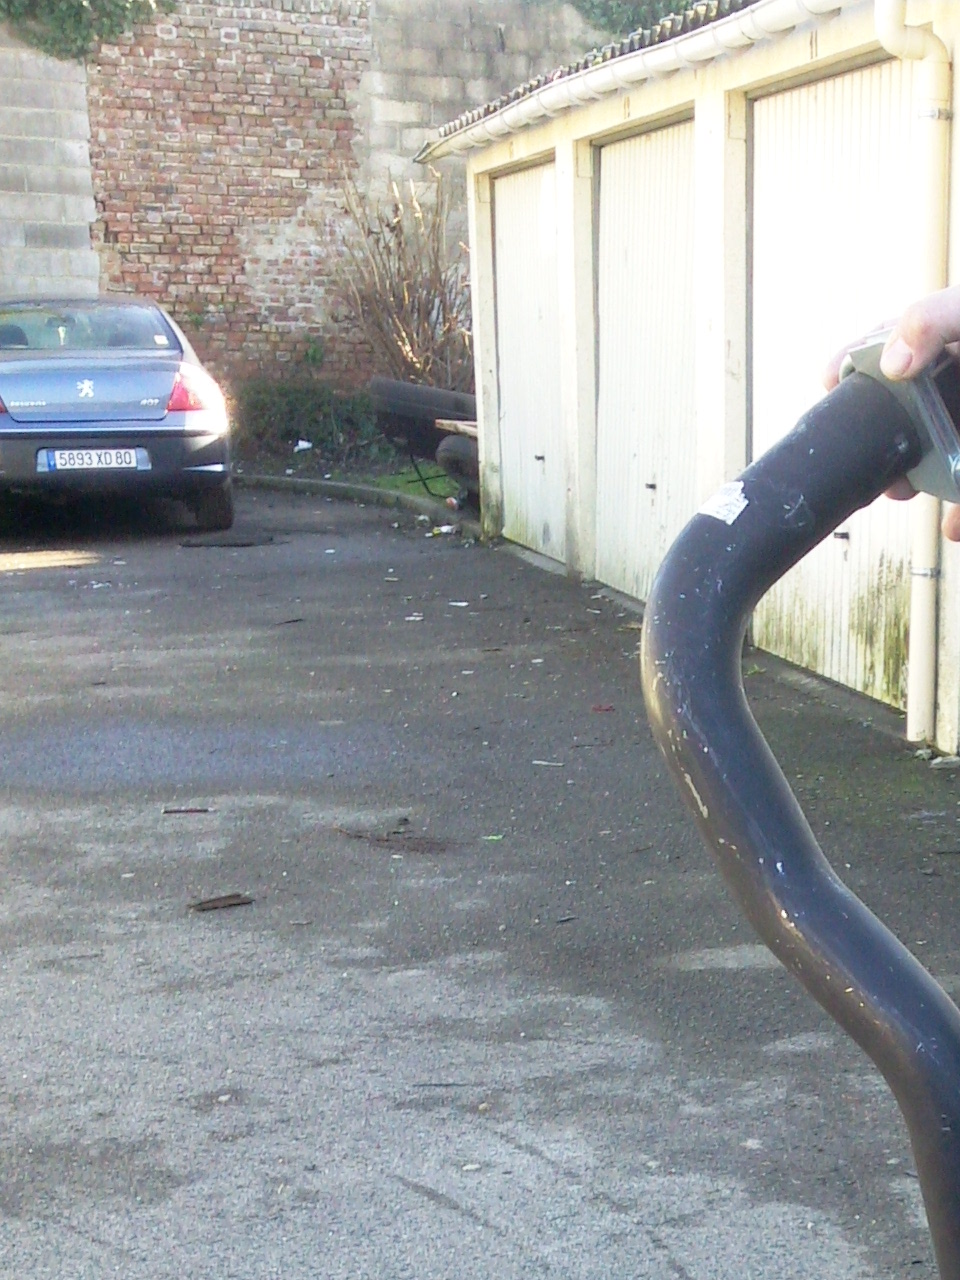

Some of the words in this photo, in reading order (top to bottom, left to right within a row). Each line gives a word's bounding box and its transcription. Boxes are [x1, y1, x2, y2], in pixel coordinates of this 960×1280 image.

[59, 452, 93, 467] 5893
[96, 451, 113, 466] XD
[115, 451, 132, 465] 80
